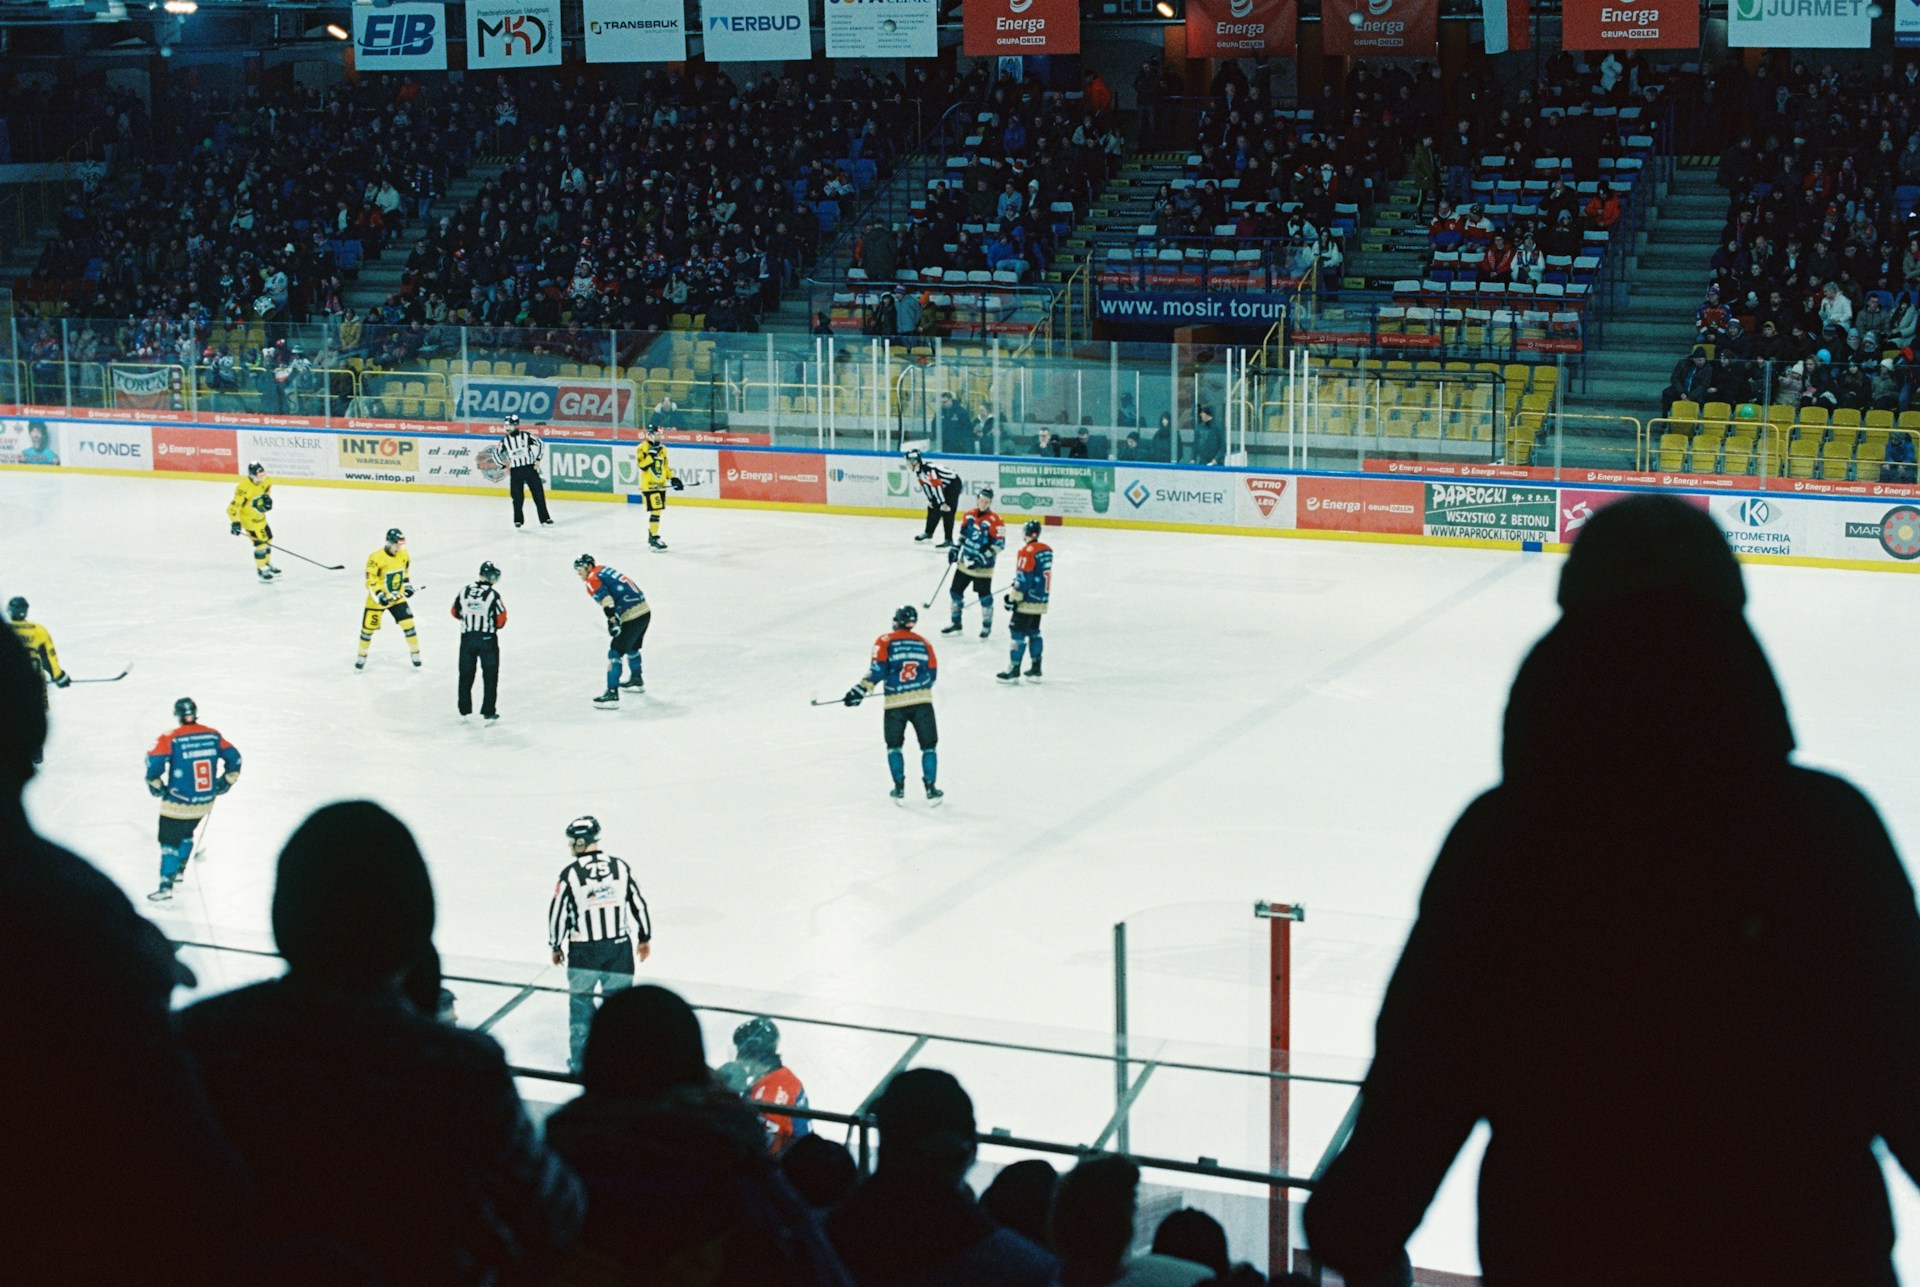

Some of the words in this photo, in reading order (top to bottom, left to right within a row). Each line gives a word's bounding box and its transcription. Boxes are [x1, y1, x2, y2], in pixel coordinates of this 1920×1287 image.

[731, 15, 801, 31] ERBUD
[1601, 8, 1659, 25] Energa
[604, 20, 678, 30] TRANSBRUK
[996, 18, 1045, 32] Energa
[1217, 21, 1265, 37] Energa
[361, 14, 436, 56] EIB
[463, 389, 551, 414] RADIO
[559, 391, 615, 416] GRA
[98, 443, 141, 457] ONDE
[343, 437, 414, 457] INTOP
[552, 452, 611, 479] MPO
[345, 473, 415, 483] www.intop.pl
[741, 470, 773, 483] Energa
[1252, 480, 1282, 489] PETRO
[1156, 489, 1223, 504] SWIMER
[1432, 484, 1507, 509] PAPROCKI
[1322, 499, 1361, 513] Energa
[1446, 511, 1495, 524] WSZYSTKO
[1500, 513, 1507, 525] Z
[1512, 514, 1550, 527] BETONU
[1431, 526, 1549, 542] WWW.PAPROCKI.TORUN.PL
[1850, 526, 1881, 536] MAR
[899, 661, 920, 682] 8
[193, 758, 213, 792] 9
[585, 861, 611, 878] 75
